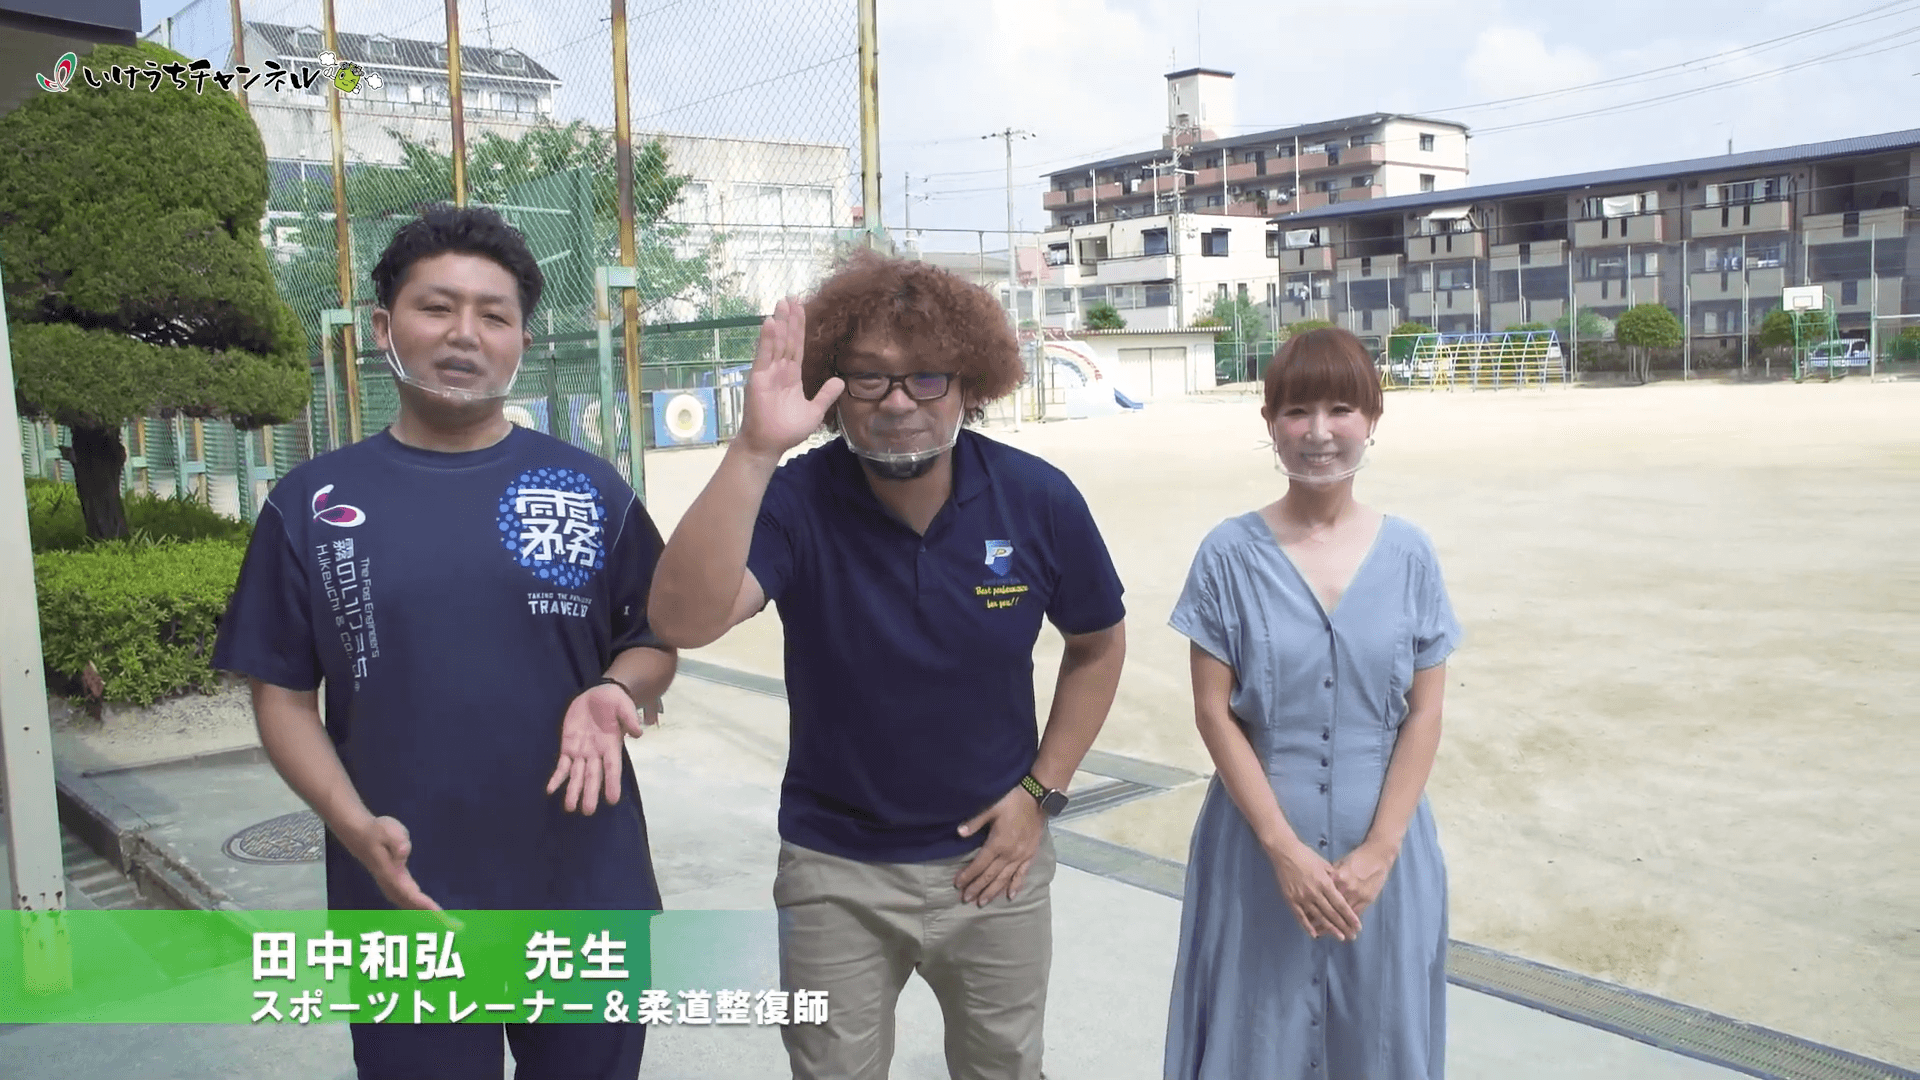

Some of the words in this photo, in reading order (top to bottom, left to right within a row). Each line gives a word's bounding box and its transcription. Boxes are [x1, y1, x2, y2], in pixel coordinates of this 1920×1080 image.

[316, 543, 340, 612] H.Ikeuchi
[360, 557, 370, 578] The
[362, 579, 372, 600] Fog
[364, 602, 379, 658] Engineers
